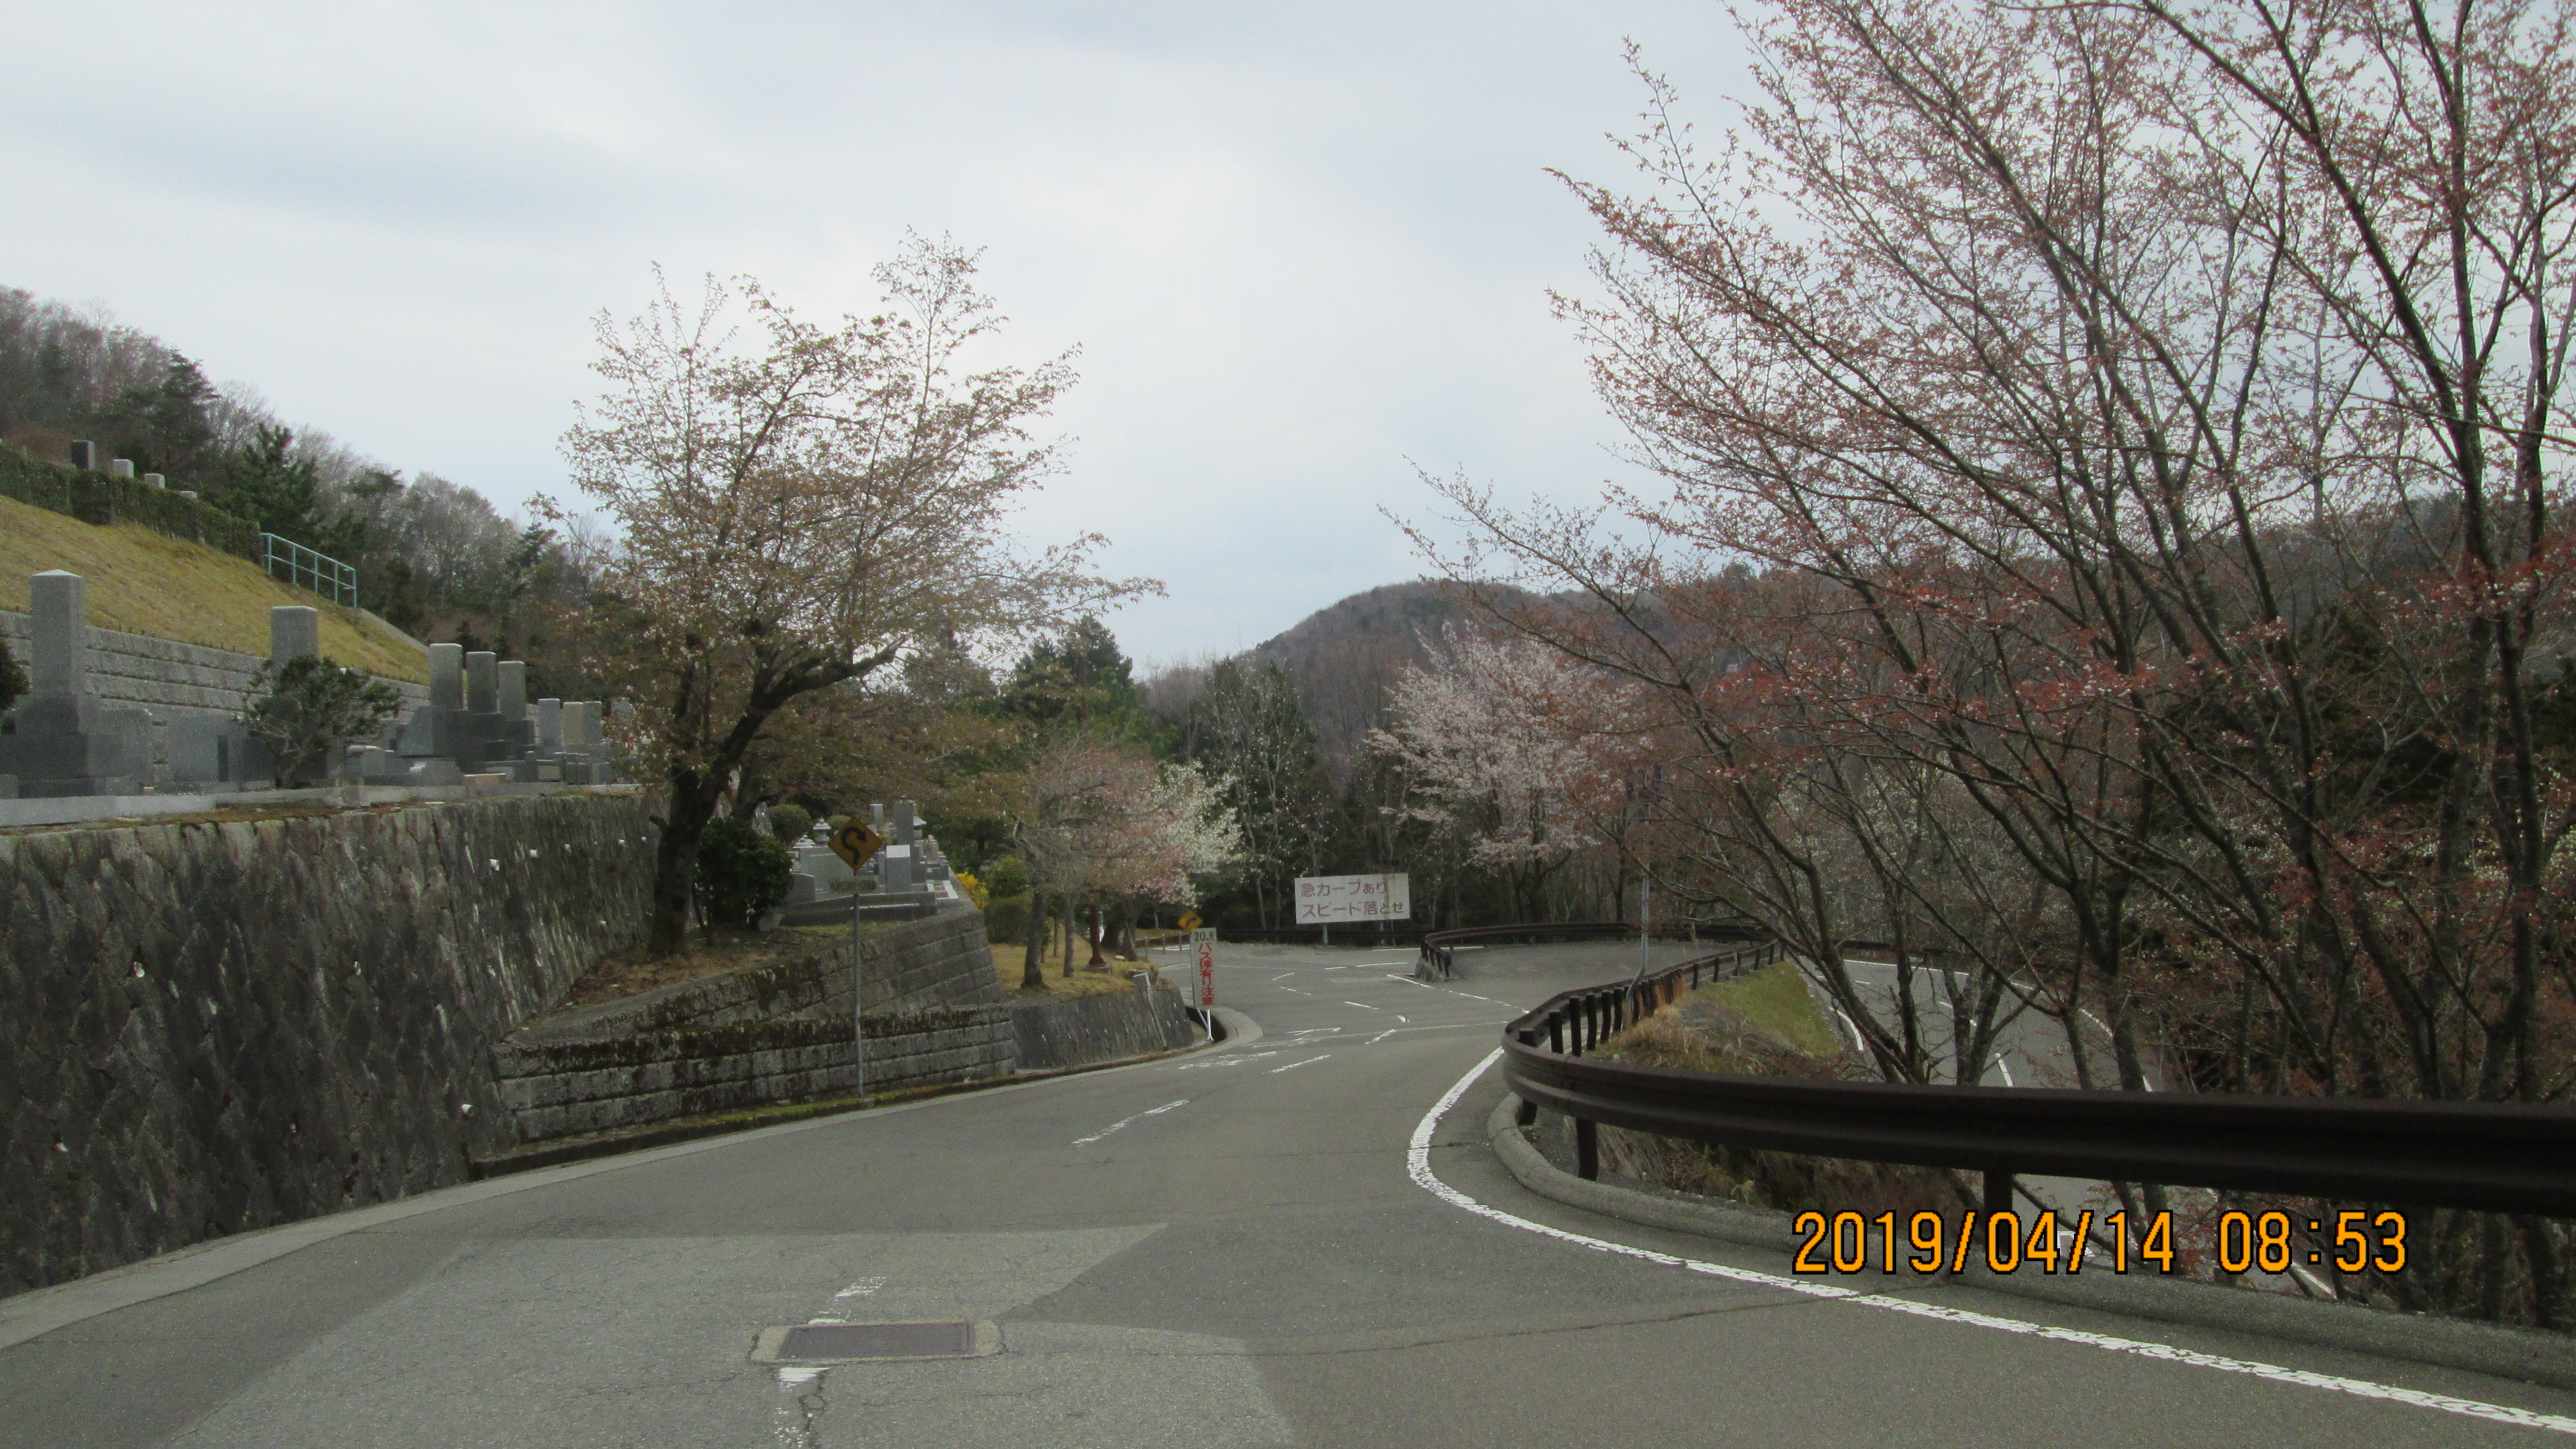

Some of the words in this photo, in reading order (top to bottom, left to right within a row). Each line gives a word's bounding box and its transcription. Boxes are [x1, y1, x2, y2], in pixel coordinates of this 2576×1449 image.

[1301, 878, 1389, 897] 急カーブあり
[1302, 900, 1404, 918] スピード落とせ
[1198, 942, 1215, 1006] バス停有り注意
